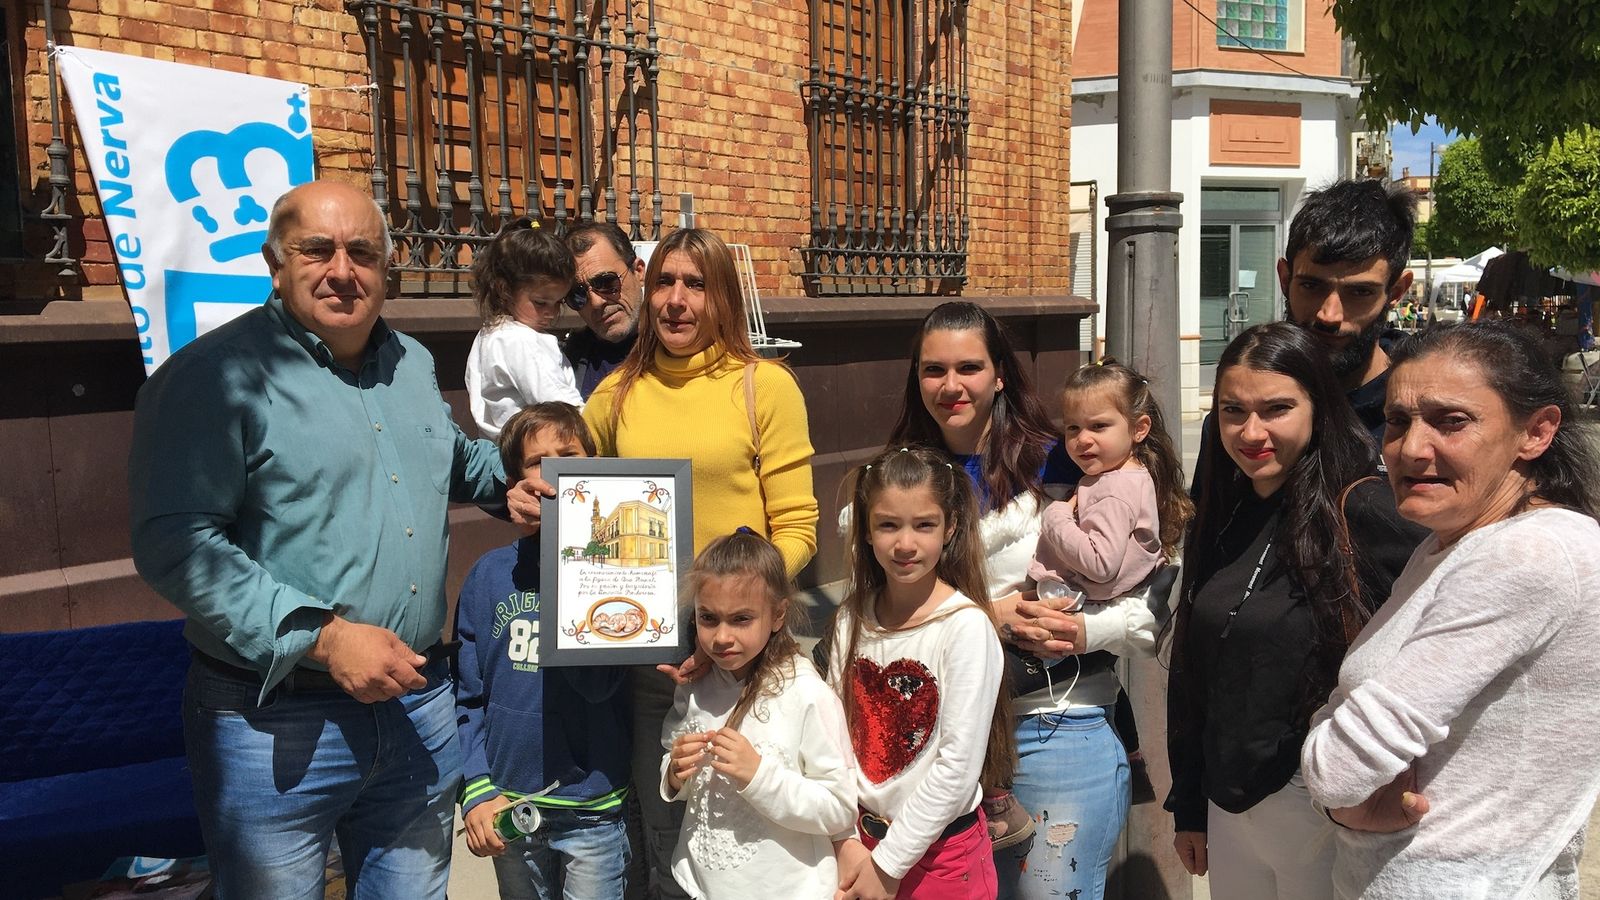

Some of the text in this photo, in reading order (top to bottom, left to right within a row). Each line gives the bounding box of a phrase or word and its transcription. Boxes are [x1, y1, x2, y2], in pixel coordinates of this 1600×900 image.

[92, 71, 137, 219] Nerva
[115, 232, 146, 291] de
[508, 619, 539, 664] 82
